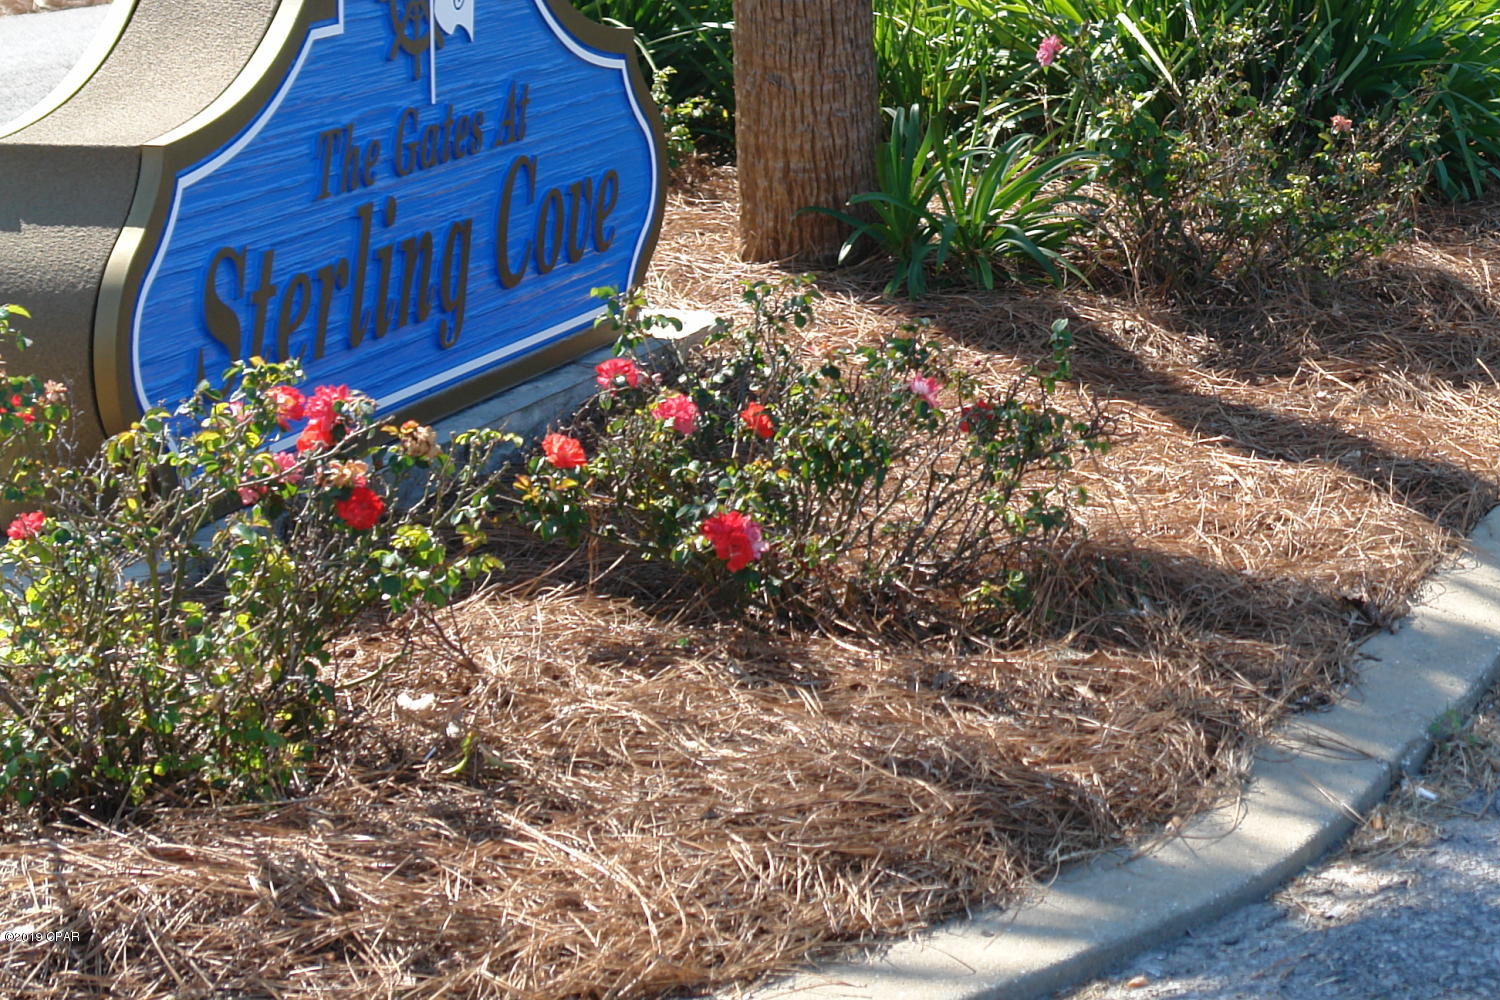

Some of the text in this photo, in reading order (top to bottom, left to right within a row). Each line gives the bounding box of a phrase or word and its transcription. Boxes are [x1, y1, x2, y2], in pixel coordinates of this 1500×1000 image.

[319, 80, 531, 199] The Gates At
[197, 155, 619, 396] Sterling Cove
